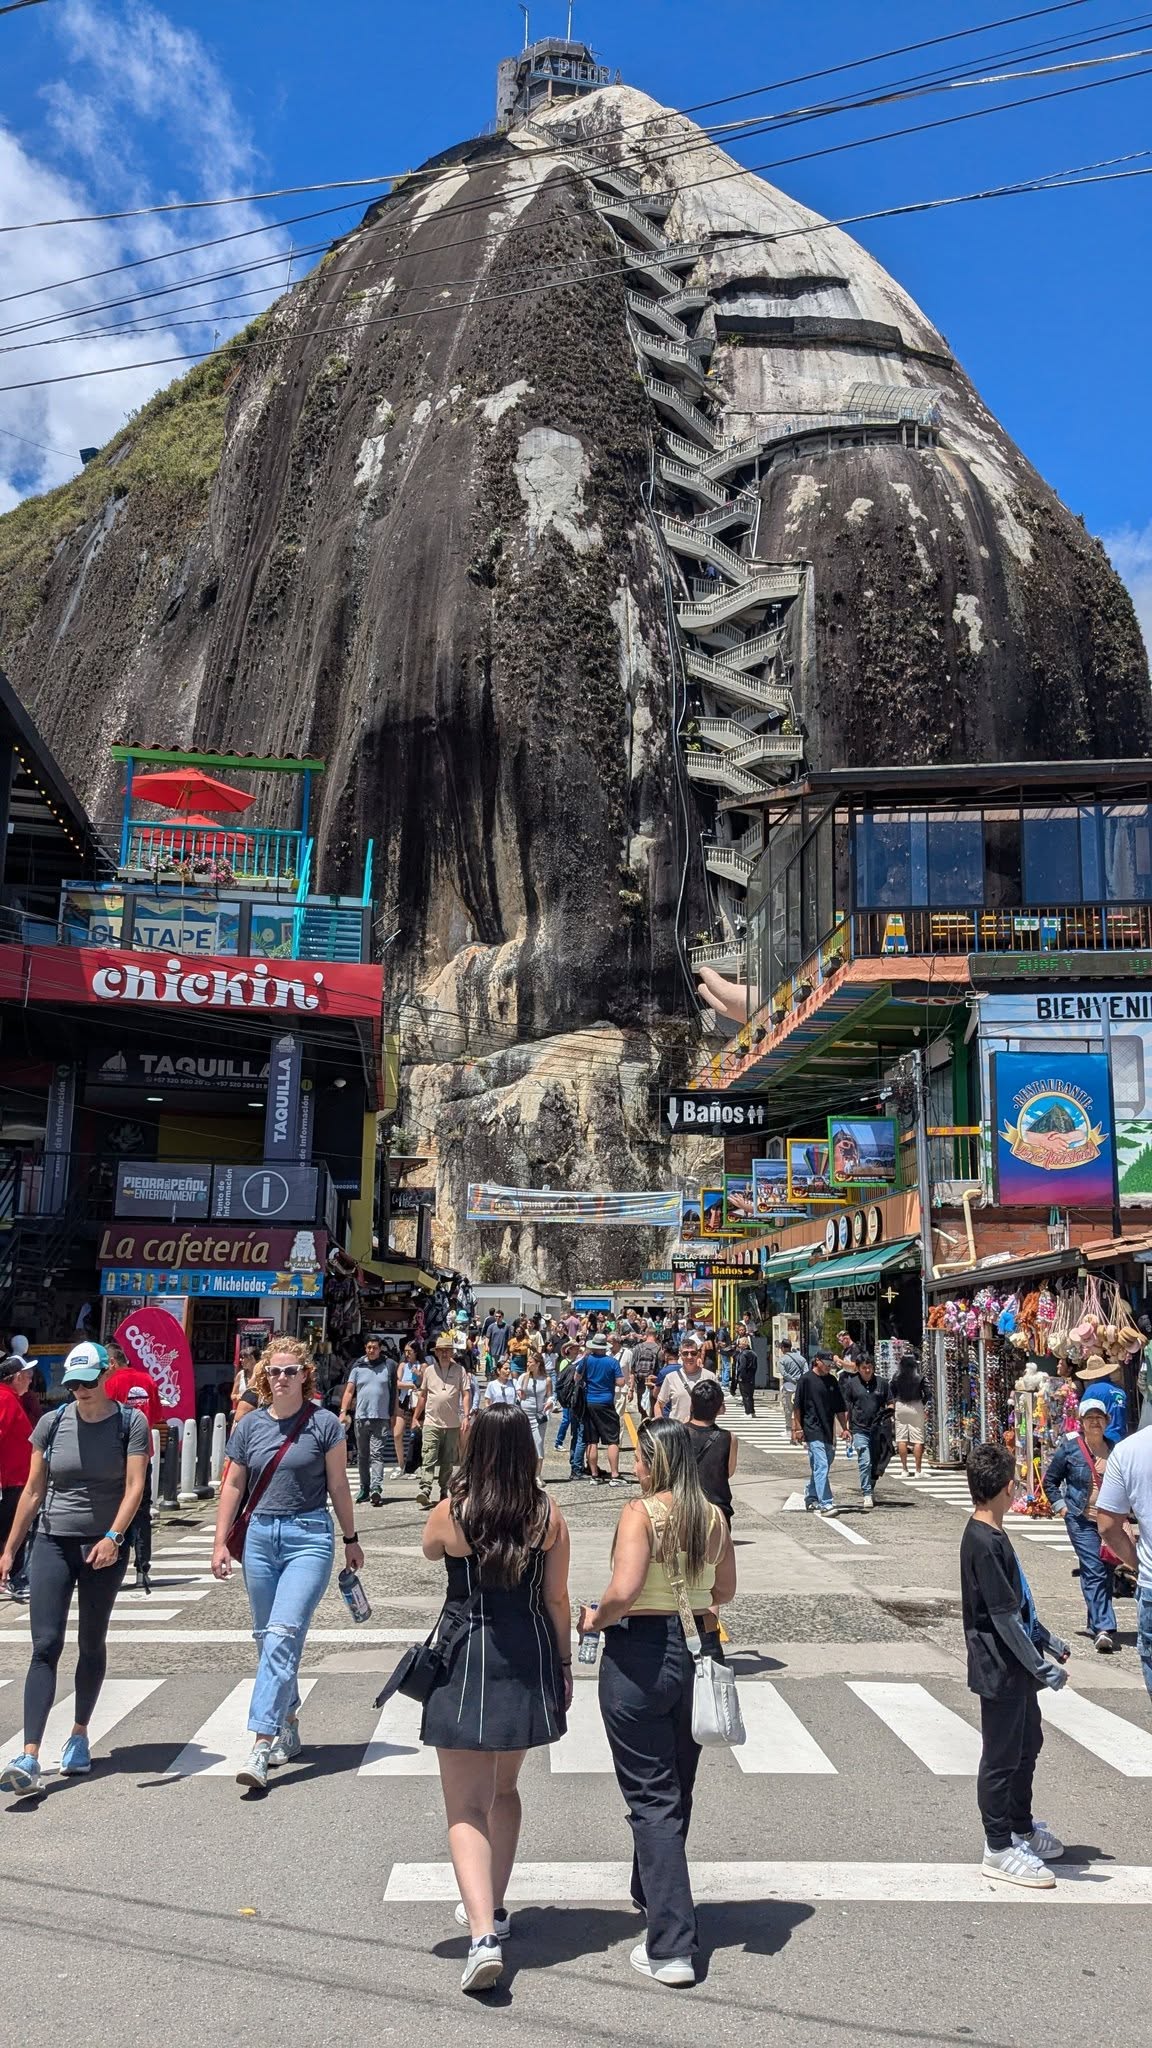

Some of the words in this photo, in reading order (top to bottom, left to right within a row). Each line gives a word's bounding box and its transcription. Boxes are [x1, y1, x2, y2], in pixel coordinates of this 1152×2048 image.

[559, 58, 623, 85] PIEDRA
[92, 924, 213, 949] GUATAPÉ
[92, 958, 323, 1010] chickin'
[1037, 996, 1152, 1019] BIENVENI
[139, 1054, 270, 1078] TAQUILLA
[273, 1058, 291, 1143] TAQUILLA
[1013, 1078, 1093, 1109] RESTAURANTE
[300, 1095, 309, 1148] Información
[683, 1101, 744, 1124] Baños
[123, 1176, 164, 1190] PIEDRA
[170, 1177, 208, 1191] PEÑOL
[134, 1189, 197, 1202] ENTERTAINMENT
[218, 1180, 225, 1191] de
[223, 1168, 233, 1217] Información
[216, 1192, 224, 1217] Punto
[99, 1230, 136, 1260] La
[143, 1232, 270, 1270] cafetería
[711, 1265, 744, 1275] Baños
[214, 1275, 267, 1292] Micheladas
[856, 1284, 876, 1296] WC
